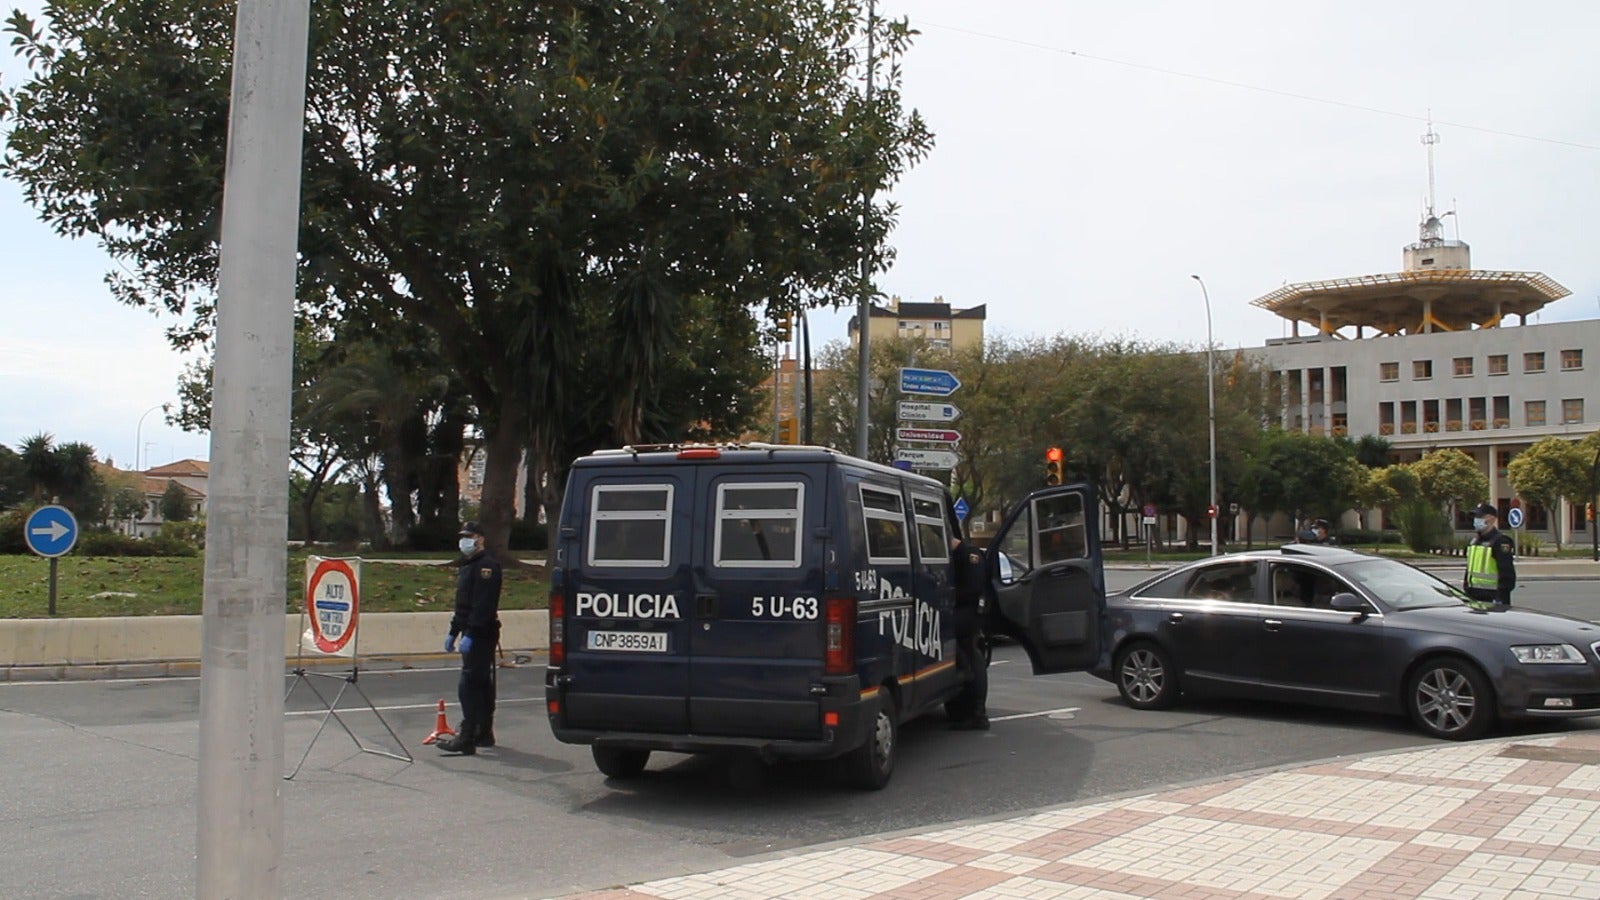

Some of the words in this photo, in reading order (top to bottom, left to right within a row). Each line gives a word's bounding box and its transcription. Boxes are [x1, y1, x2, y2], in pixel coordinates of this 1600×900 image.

[901, 404, 931, 412] Hospital
[900, 431, 945, 440] Universidad
[900, 451, 924, 459] Parque
[326, 584, 344, 599] ALTO
[576, 592, 680, 619] POLICIA
[751, 597, 764, 616] 5
[769, 597, 819, 620] U-63
[320, 611, 344, 624] CONTROL
[879, 577, 942, 661] POLICIA
